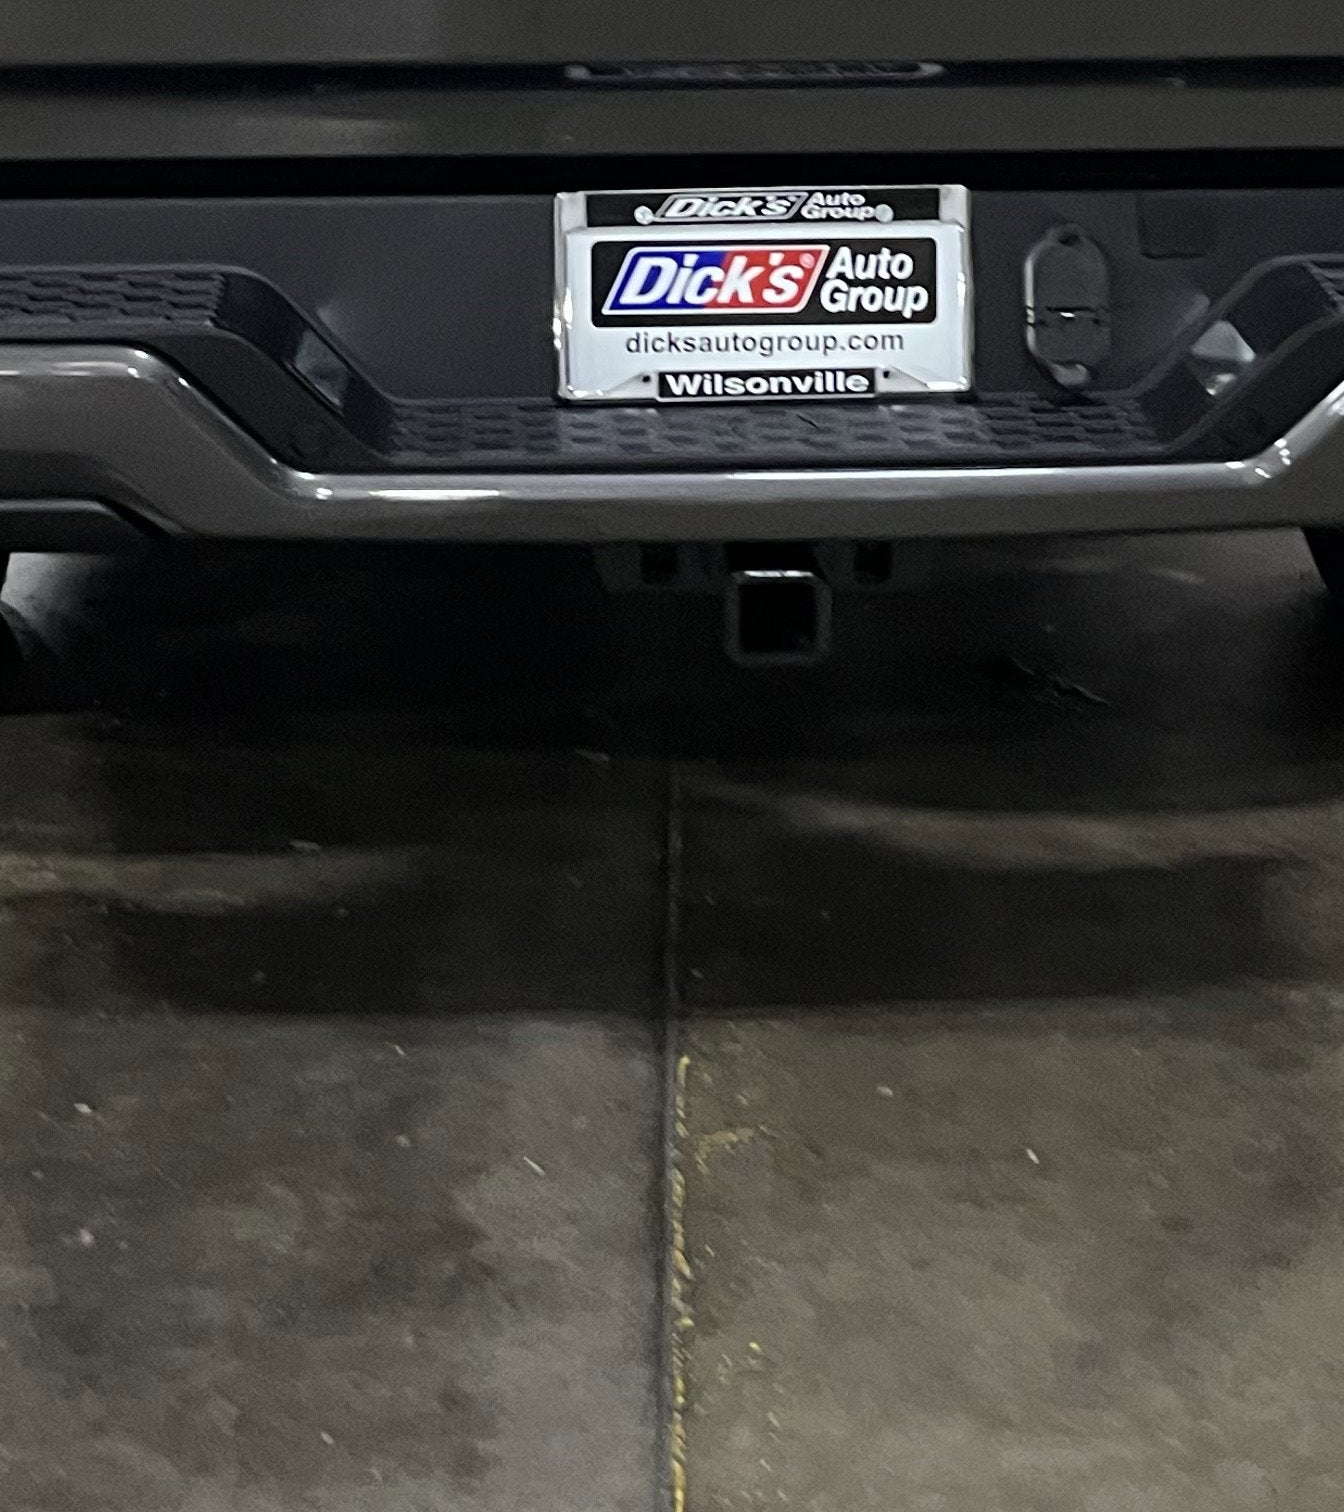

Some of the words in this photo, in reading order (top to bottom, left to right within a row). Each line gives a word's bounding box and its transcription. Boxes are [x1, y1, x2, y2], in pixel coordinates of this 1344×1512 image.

[808, 192, 865, 206] Auto
[801, 205, 876, 221] Group
[619, 253, 805, 305] Dick's
[826, 246, 914, 280] Auto
[820, 279, 929, 319] Group
[626, 332, 904, 356] dicksautogroup.com
[665, 370, 869, 396] Wilsonville
